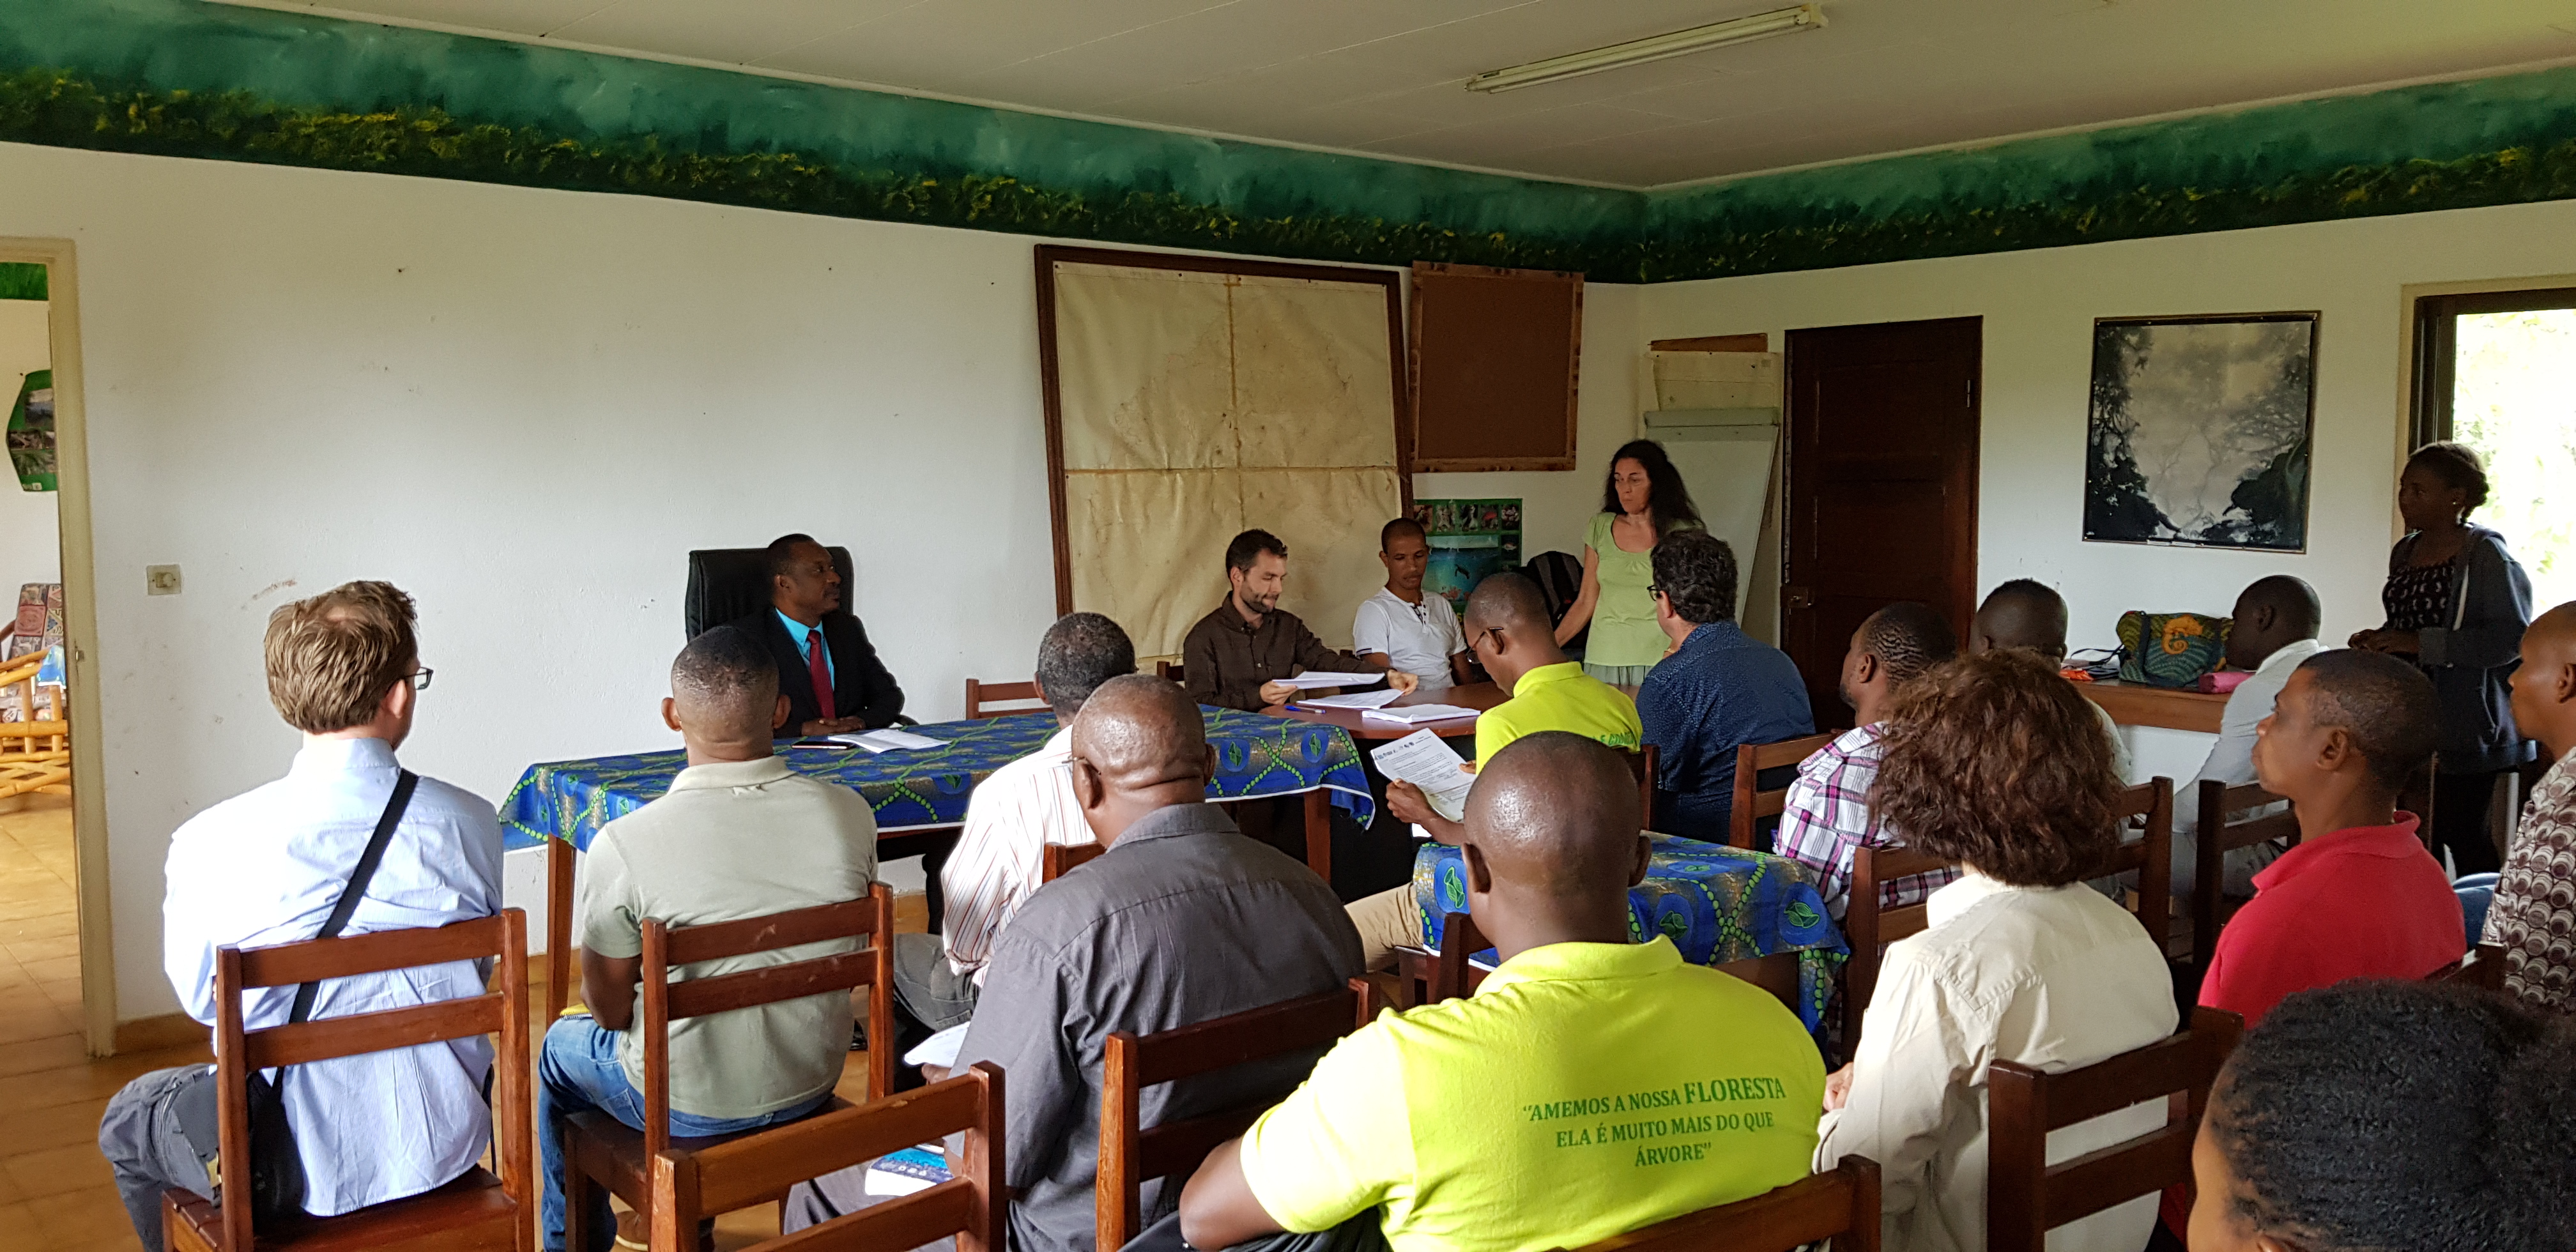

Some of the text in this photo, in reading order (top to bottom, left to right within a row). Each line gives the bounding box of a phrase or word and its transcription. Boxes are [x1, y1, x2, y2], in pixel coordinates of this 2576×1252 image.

[1614, 1096, 1626, 1112] A
[1628, 1089, 1682, 1110] NOSSA
[1683, 1077, 1786, 1104] FLORESTA
[1556, 1111, 1774, 1147] ELA É MUITO MAIS DO QUE
